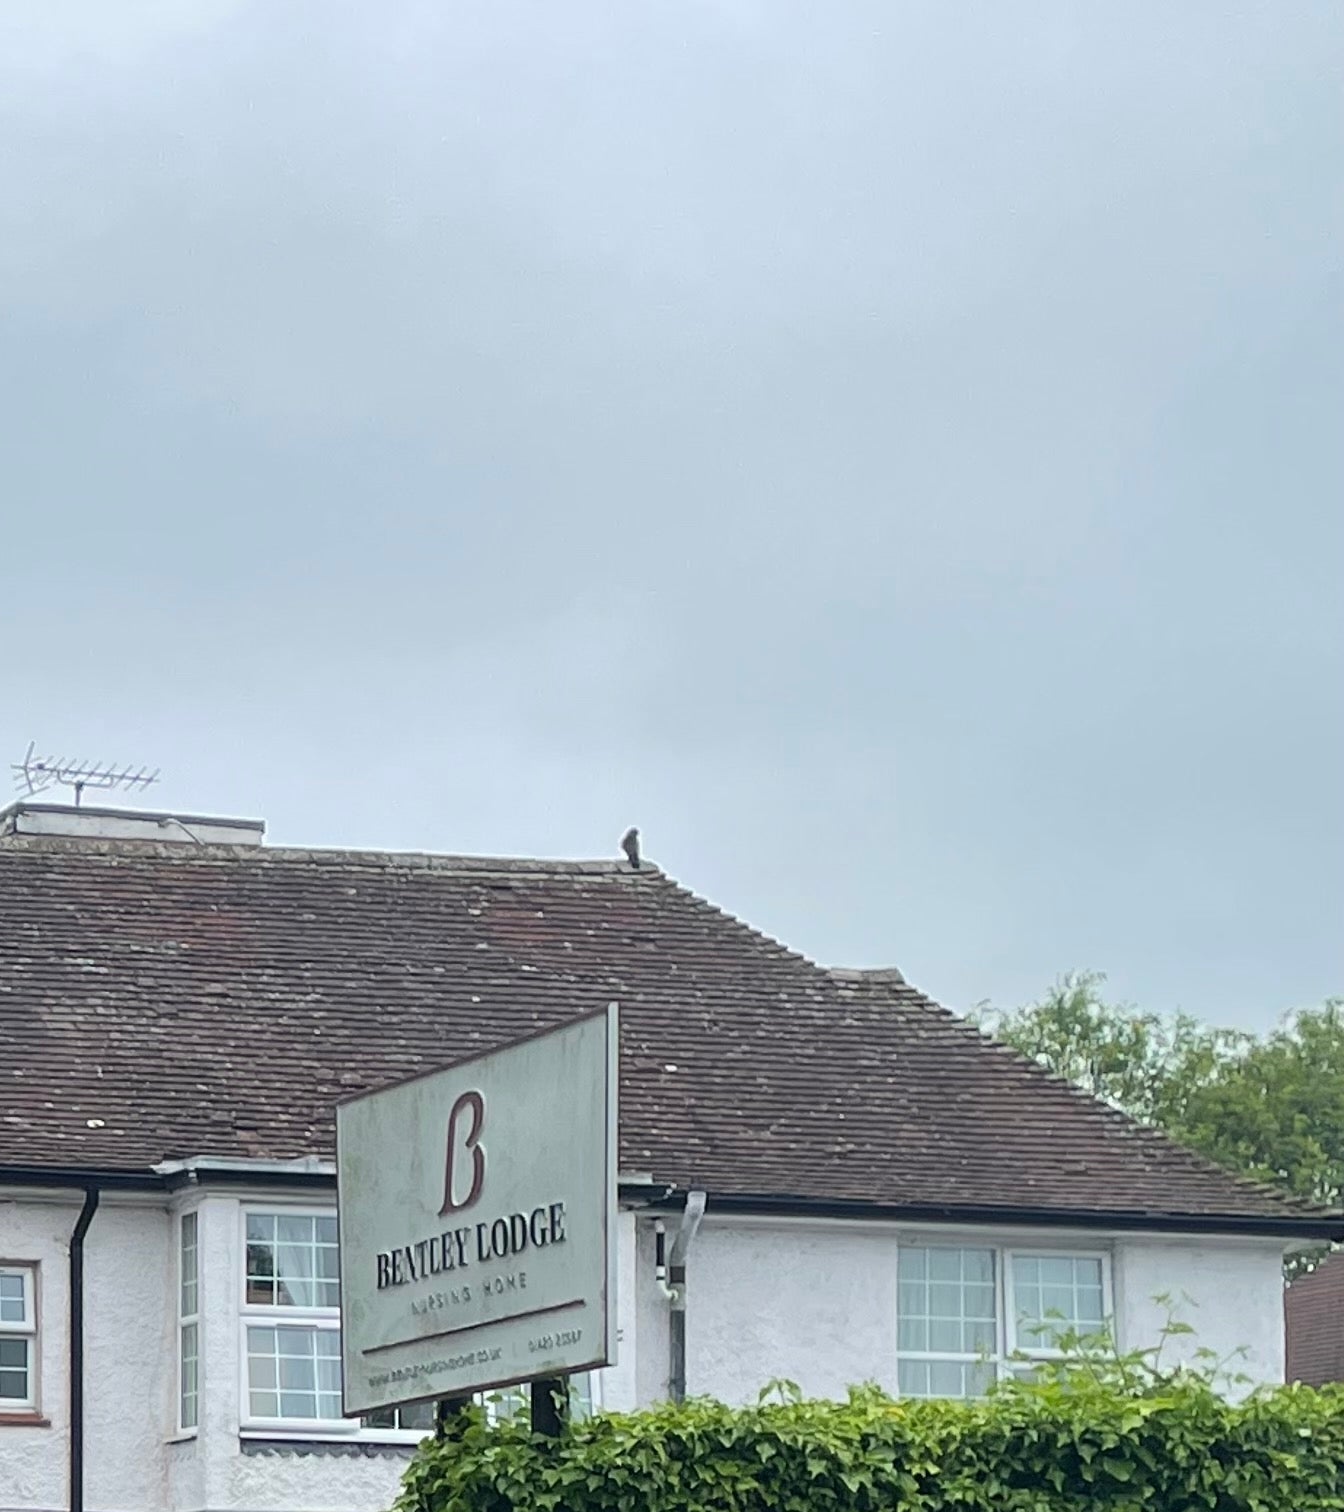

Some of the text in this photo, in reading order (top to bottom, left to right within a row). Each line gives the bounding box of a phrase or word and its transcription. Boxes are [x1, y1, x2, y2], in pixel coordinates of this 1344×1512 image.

[376, 1202, 567, 1291] BENTLEY LODGE
[411, 1271, 528, 1316] NURSING HOME
